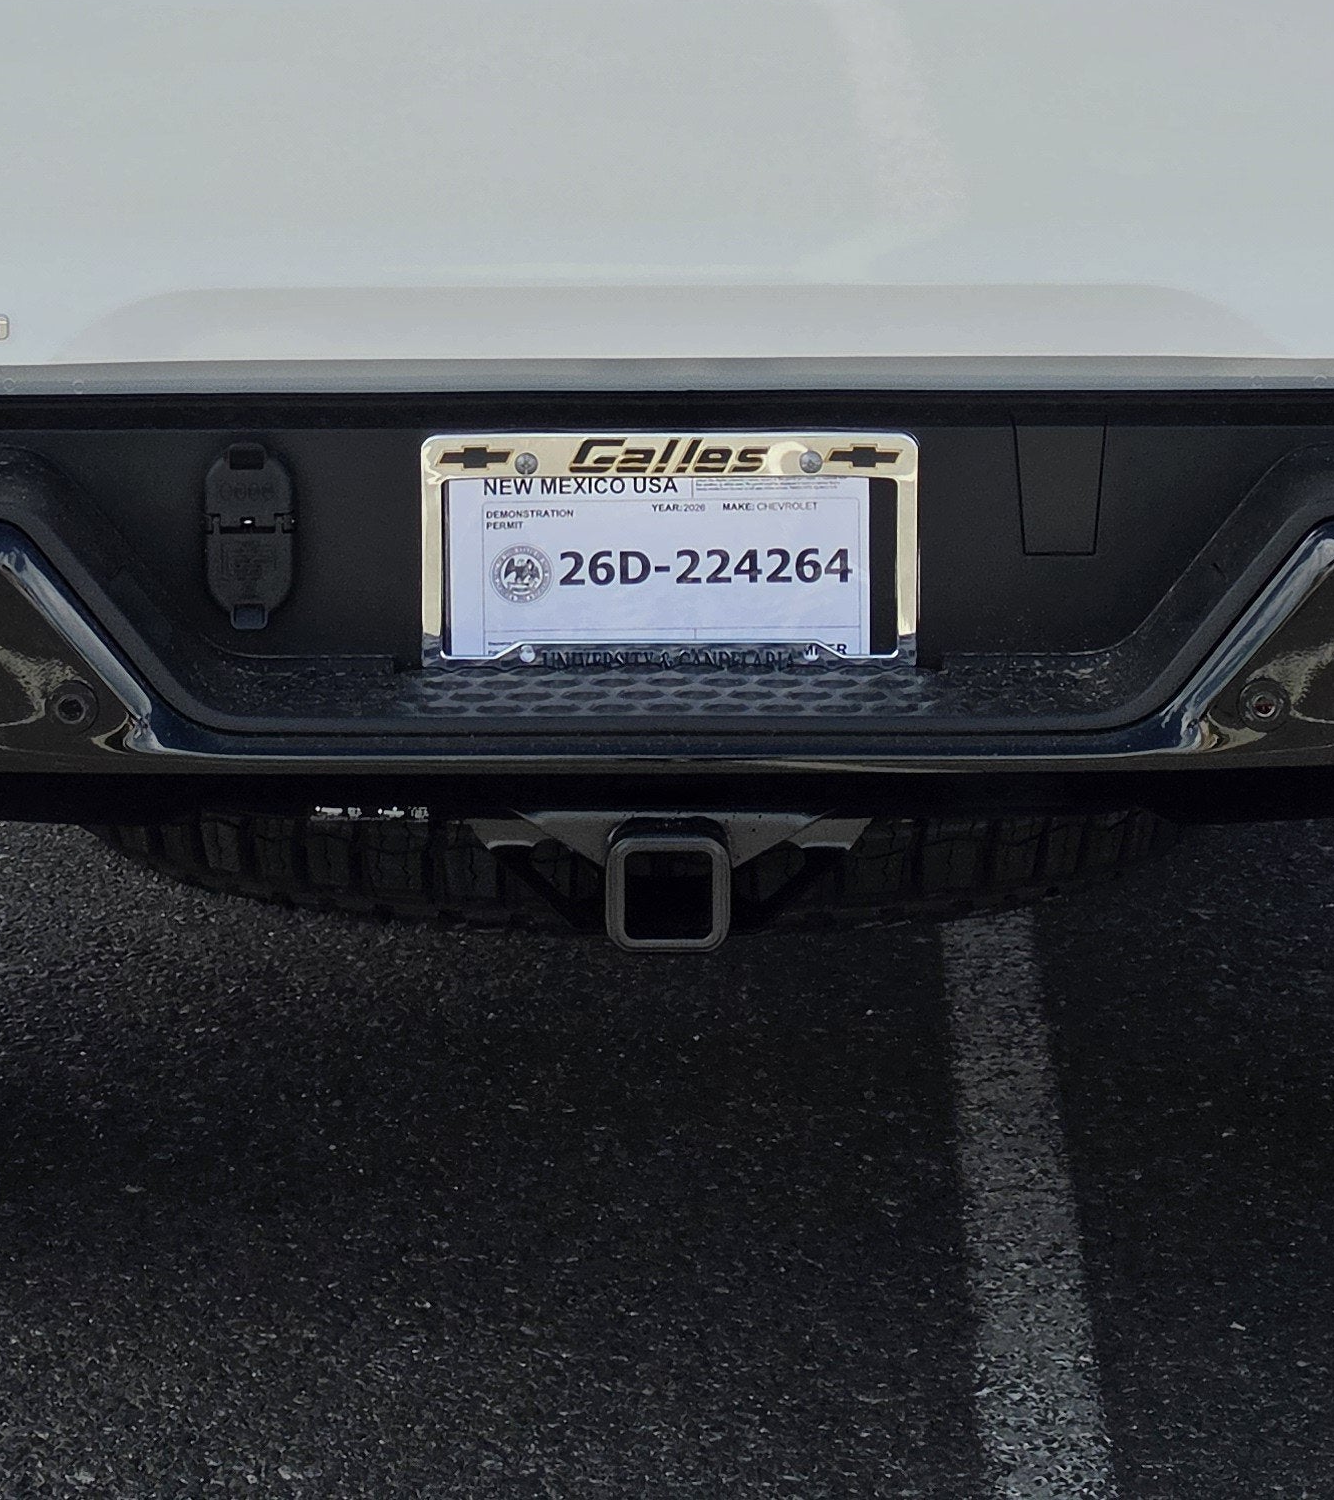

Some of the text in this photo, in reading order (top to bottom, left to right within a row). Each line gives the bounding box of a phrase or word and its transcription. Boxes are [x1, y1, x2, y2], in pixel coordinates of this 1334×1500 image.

[568, 437, 771, 474] Galles
[483, 477, 533, 496] NEW
[540, 477, 626, 495] MEXICO
[633, 477, 679, 494] USA
[756, 501, 818, 511] CHEVROLET
[485, 509, 575, 520] DEMONSTRATION
[485, 520, 524, 531] PERMIT
[559, 548, 854, 587] 26D-224264
